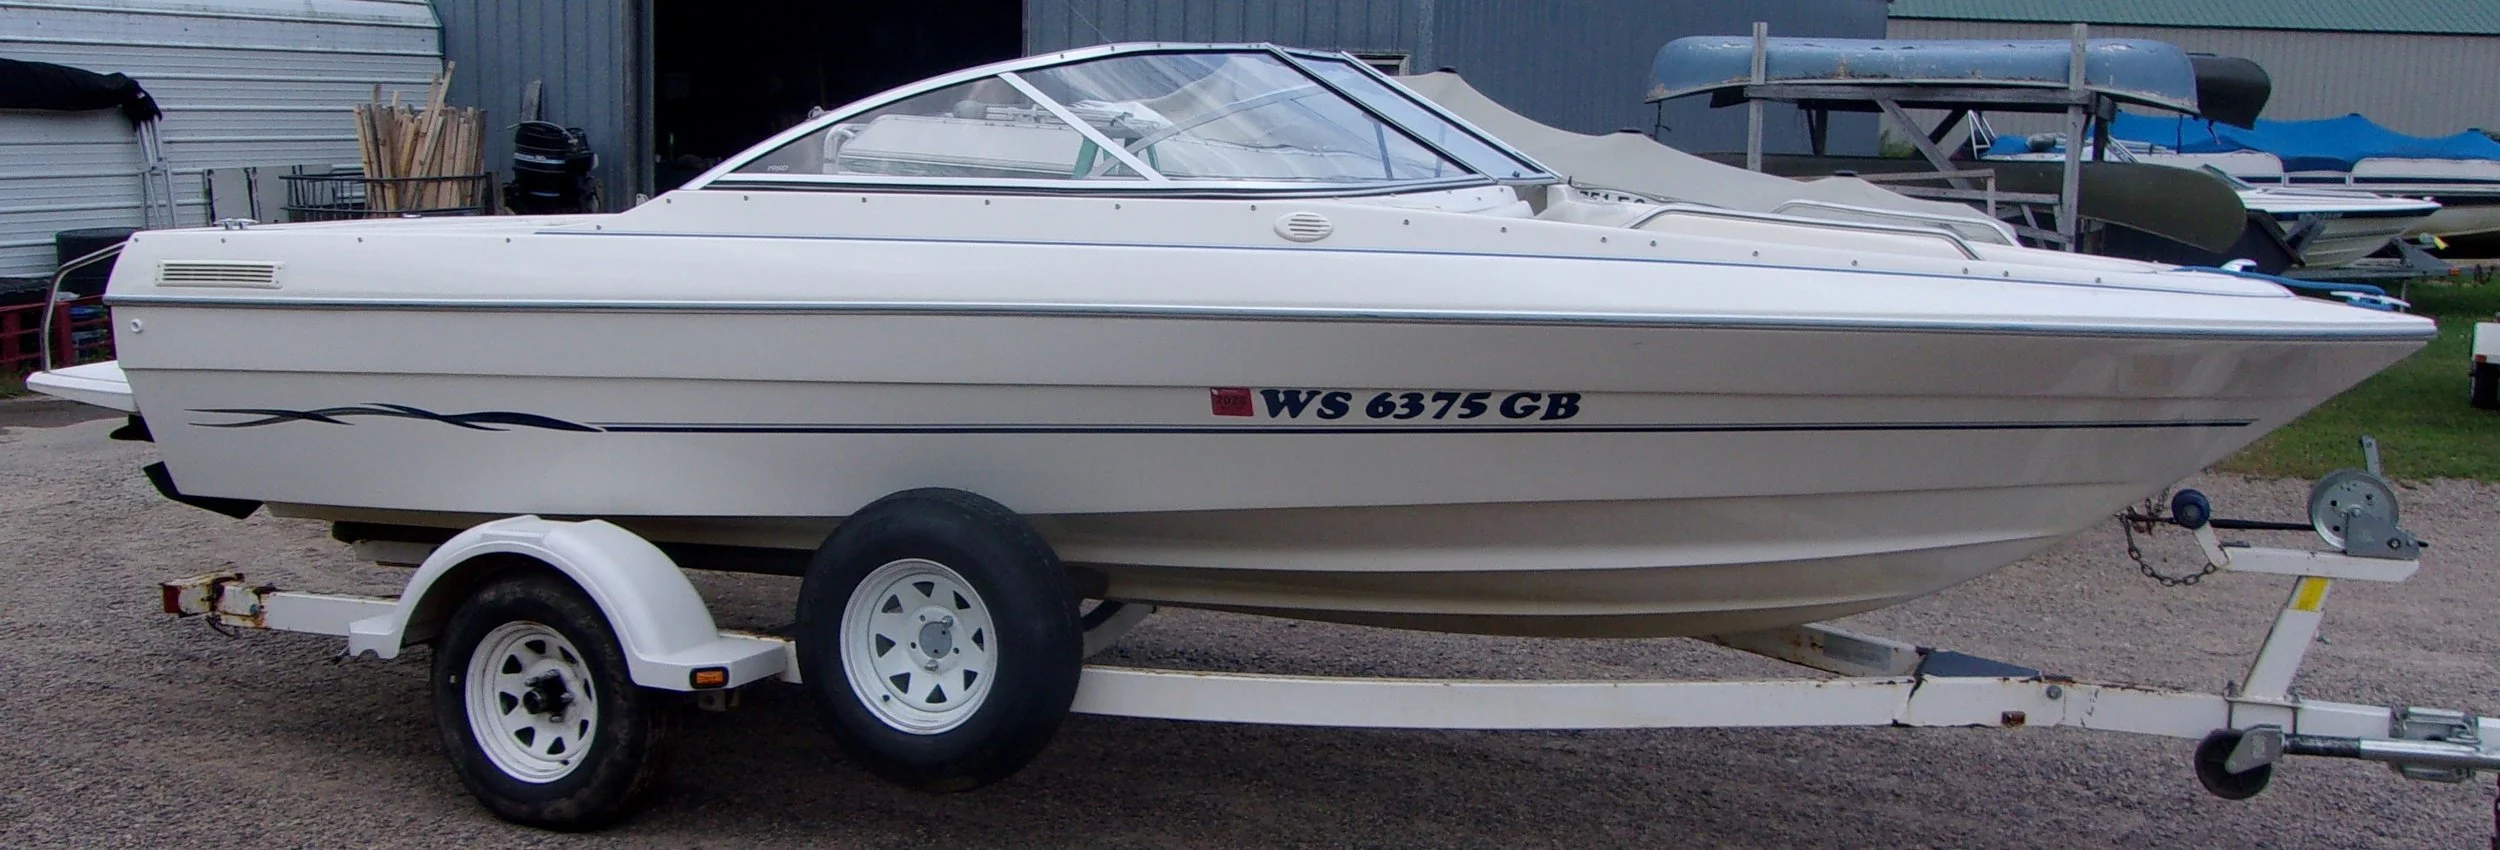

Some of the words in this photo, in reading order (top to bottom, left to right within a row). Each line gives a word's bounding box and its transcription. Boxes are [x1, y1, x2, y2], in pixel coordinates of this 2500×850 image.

[1260, 389, 1352, 419] WS
[1365, 391, 1492, 419] 6375
[1500, 392, 1581, 420] GB
